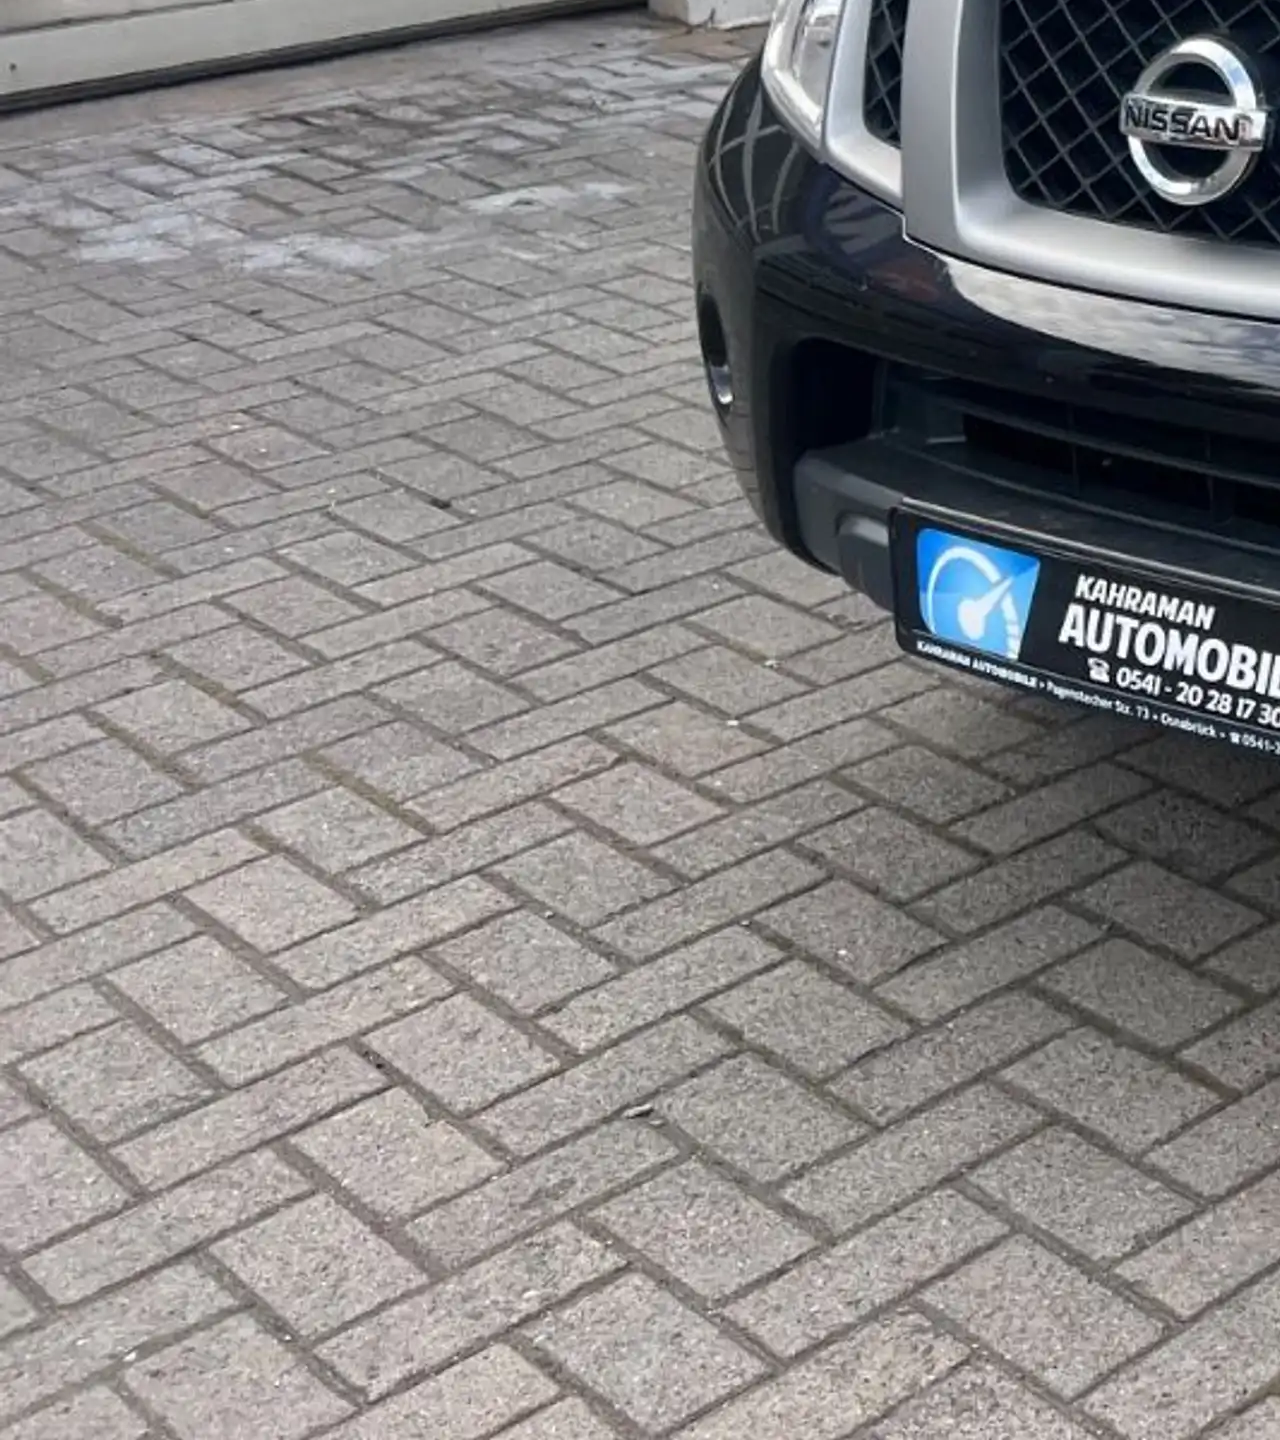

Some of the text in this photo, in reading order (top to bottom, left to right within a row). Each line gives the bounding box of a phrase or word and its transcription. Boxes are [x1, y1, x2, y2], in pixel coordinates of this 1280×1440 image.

[1125, 98, 1240, 141] NISSAN
[1075, 573, 1216, 631] KAHRAMAN
[1115, 666, 1162, 697] 0541
[1175, 681, 1203, 707] 20
[1205, 689, 1233, 715] 28
[1235, 698, 1256, 720] 17
